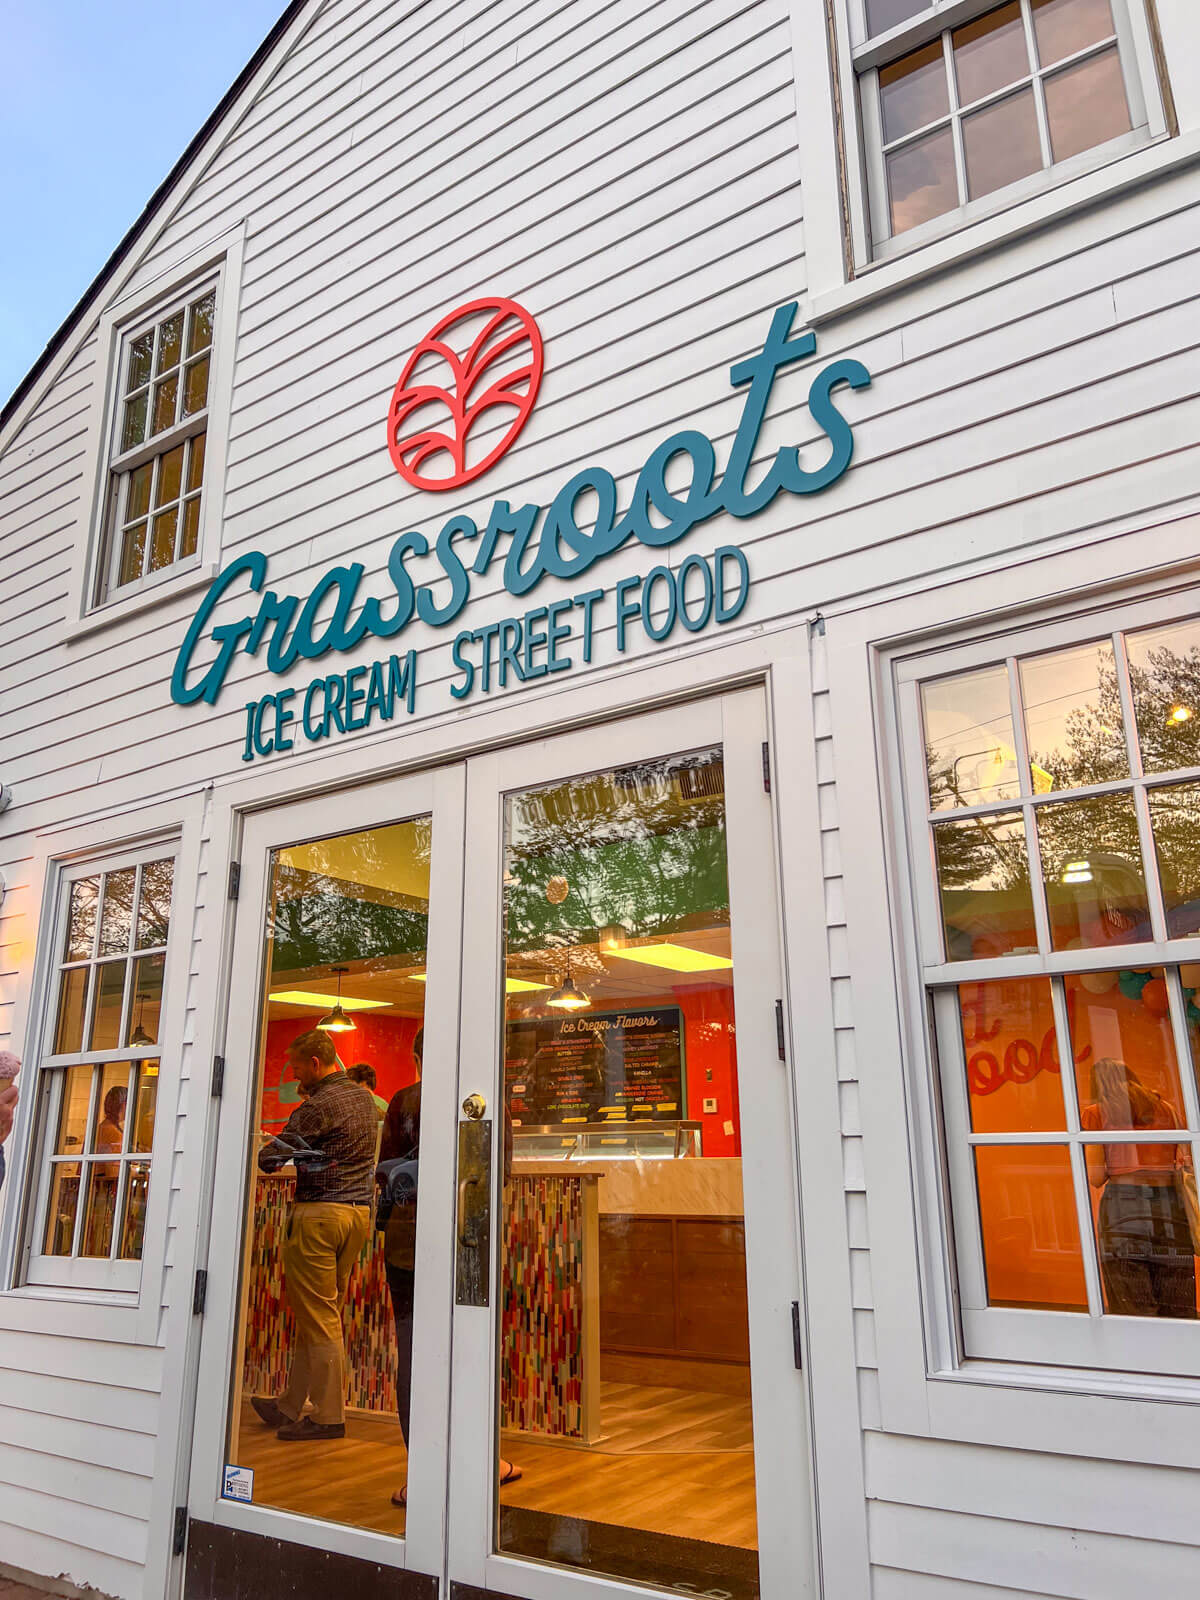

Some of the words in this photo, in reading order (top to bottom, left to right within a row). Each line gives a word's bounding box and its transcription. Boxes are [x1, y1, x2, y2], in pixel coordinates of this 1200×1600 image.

[170, 301, 872, 705] Grassroots
[242, 687, 296, 761] ICE
[302, 648, 417, 741] CREAM
[450, 589, 605, 700] STREET
[616, 545, 750, 653] FOOD
[560, 1020, 576, 1033] Ice
[577, 1018, 611, 1032] Cream
[613, 1015, 658, 1029] Flavors
